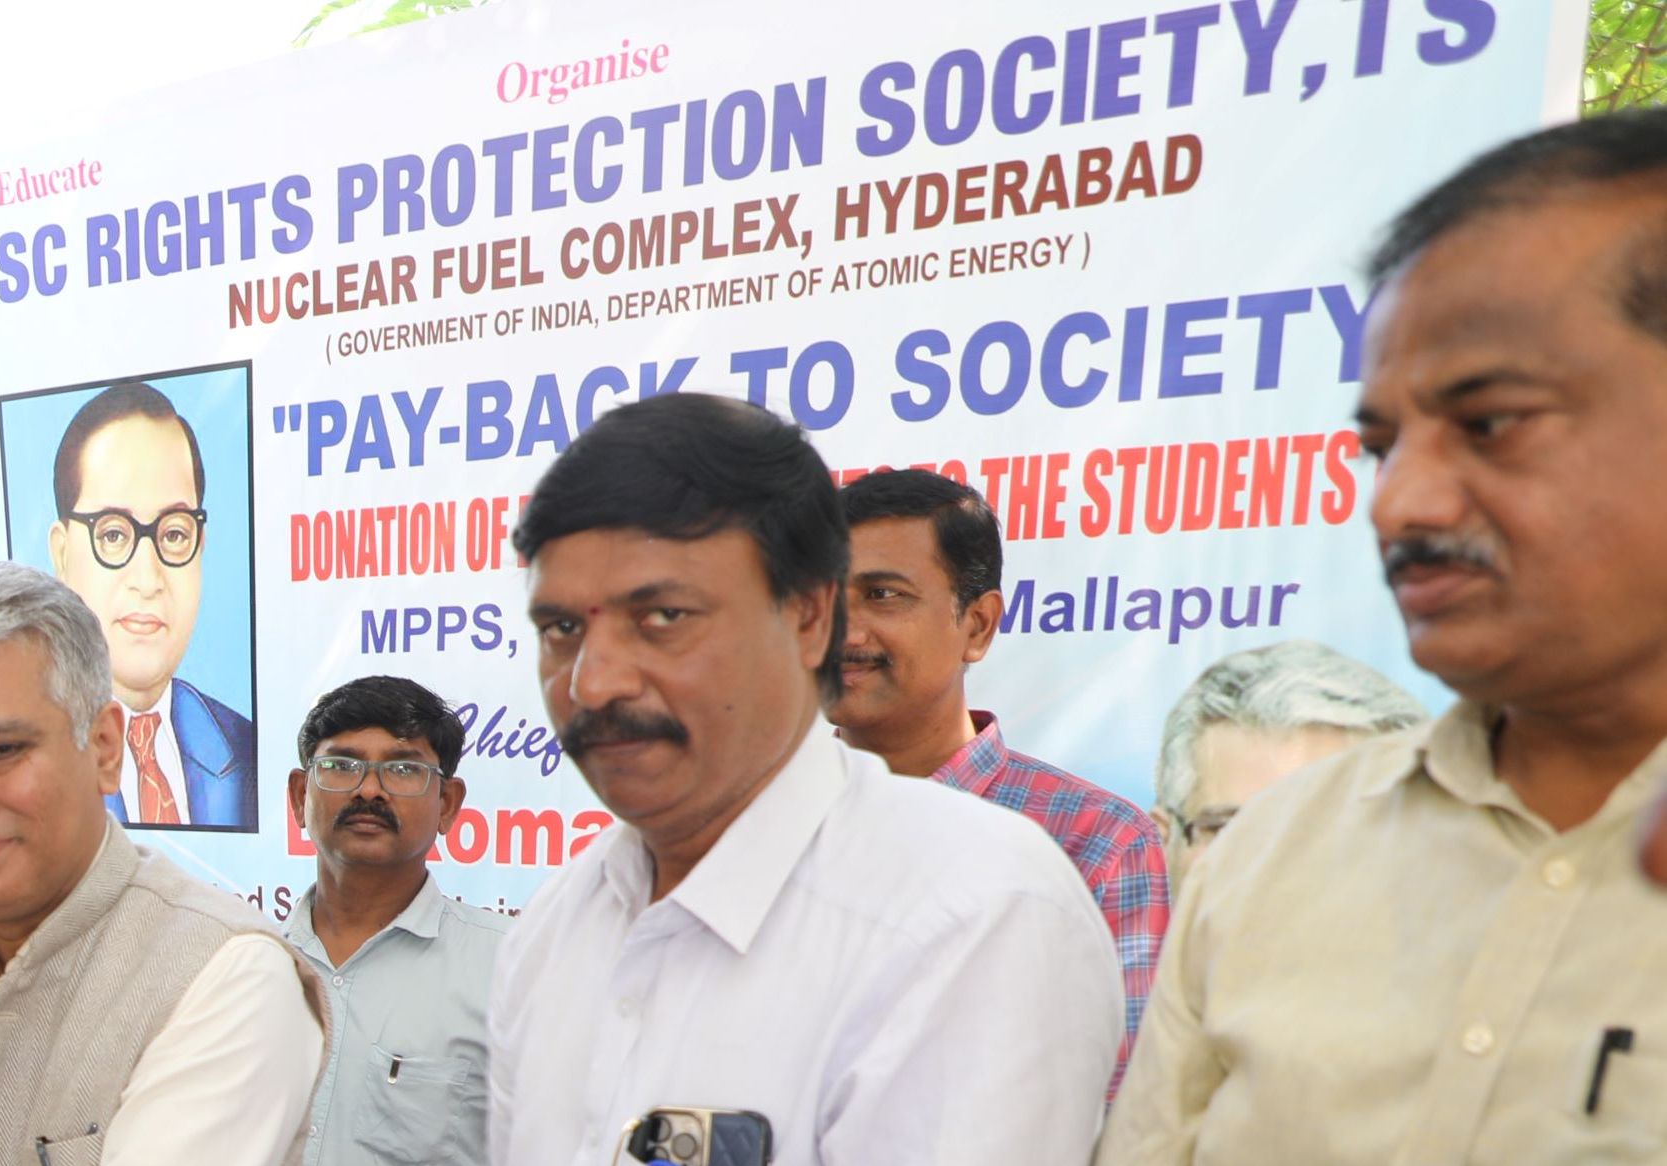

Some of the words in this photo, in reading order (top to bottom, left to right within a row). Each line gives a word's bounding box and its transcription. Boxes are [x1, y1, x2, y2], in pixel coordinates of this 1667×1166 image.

[496, 38, 670, 105] Organise
[86, 175, 313, 288] RIGHTS
[337, 76, 827, 244] PROTECTION
[229, 254, 418, 329] NUCLEAR
[433, 237, 545, 299] FUEL
[561, 193, 813, 280] COMPLEX,
[834, 133, 1203, 242] HYDERABAD
[494, 307, 525, 337] OF
[532, 299, 600, 332] INDIA,
[607, 273, 780, 322] DEPARTMENT
[787, 267, 823, 299] OF
[830, 251, 939, 294] ATOMIC
[731, 340, 854, 431] TO
[890, 283, 1371, 423] SOCIETY
[290, 501, 457, 582] DONATION
[466, 496, 509, 572] OF
[980, 452, 1070, 541] THE
[1079, 430, 1360, 538] STUDENTS
[361, 603, 517, 658] MPPS,
[999, 576, 1301, 645] Mallapur
